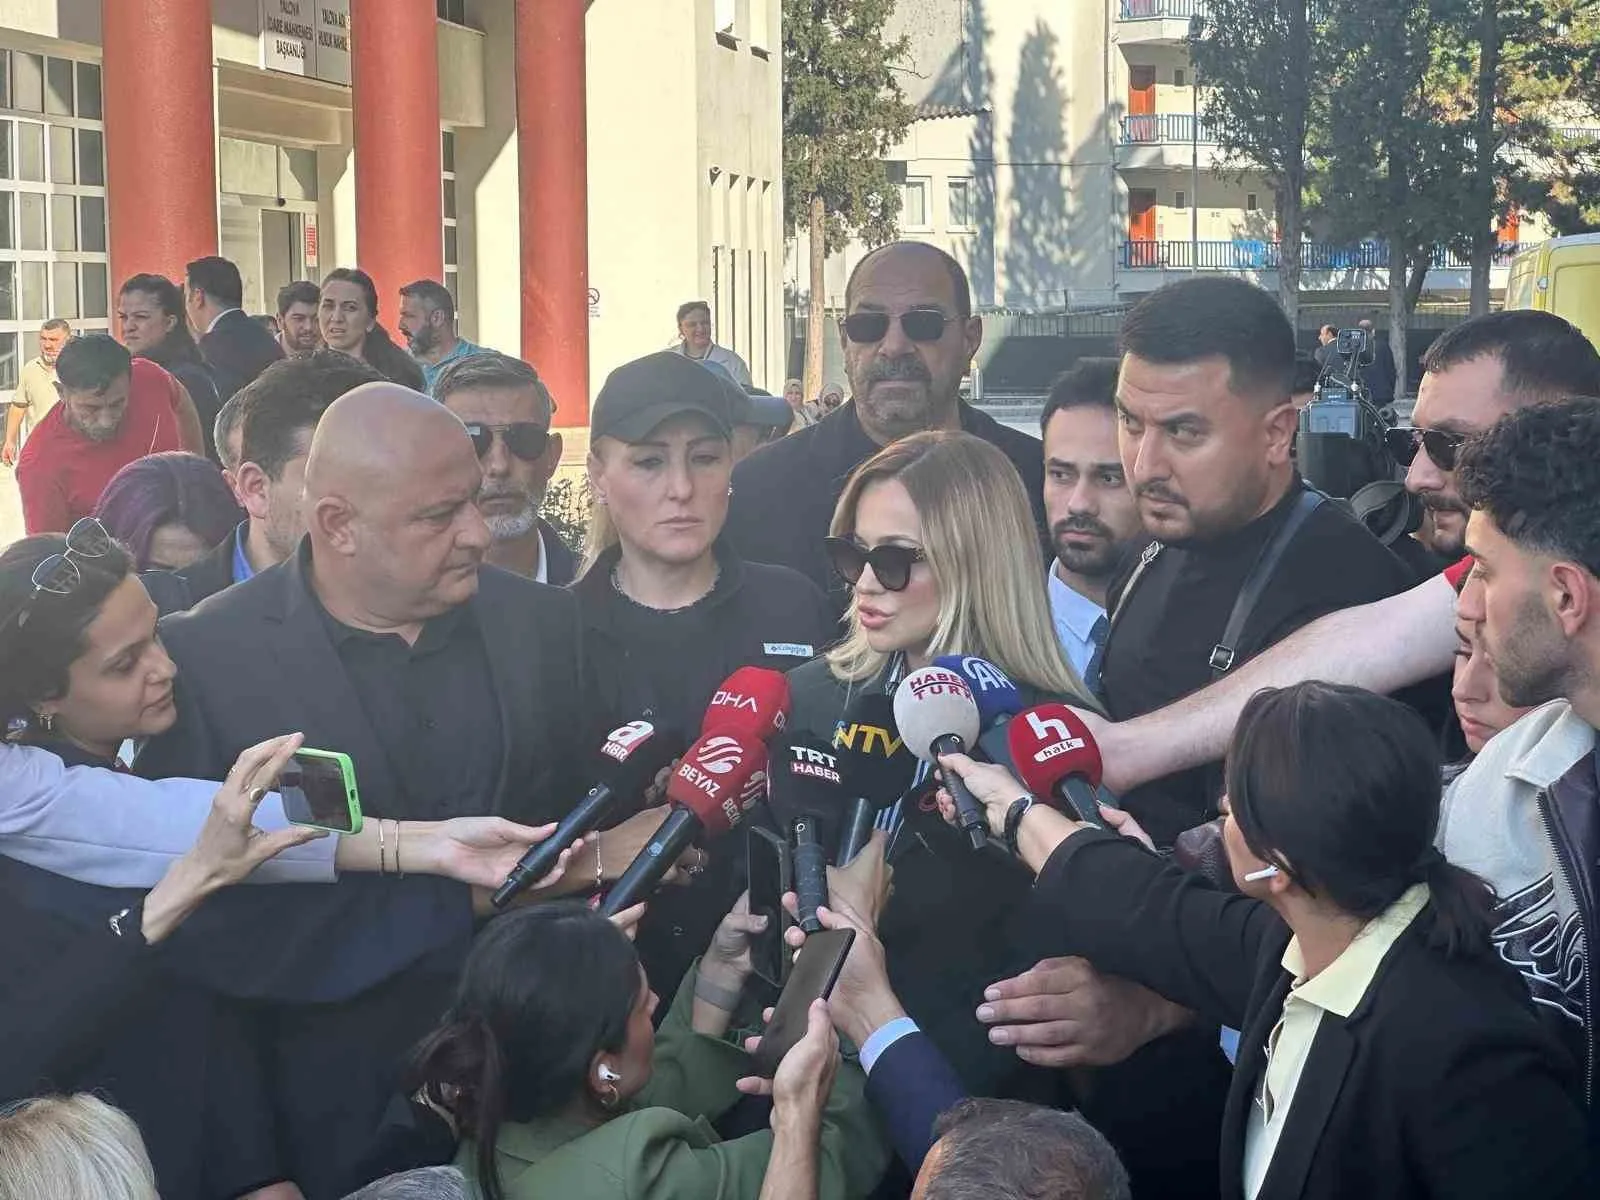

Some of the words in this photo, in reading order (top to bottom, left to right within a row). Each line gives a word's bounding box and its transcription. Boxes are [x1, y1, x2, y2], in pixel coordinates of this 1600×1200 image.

[711, 690, 758, 713] DHA
[607, 720, 654, 747] a
[1025, 711, 1072, 740] h
[601, 740, 629, 762] HBR
[832, 722, 903, 758] NTV
[1043, 741, 1075, 757] halk
[790, 745, 838, 768] TRT
[678, 763, 721, 798] BEYAZ
[792, 762, 841, 783] HABER
